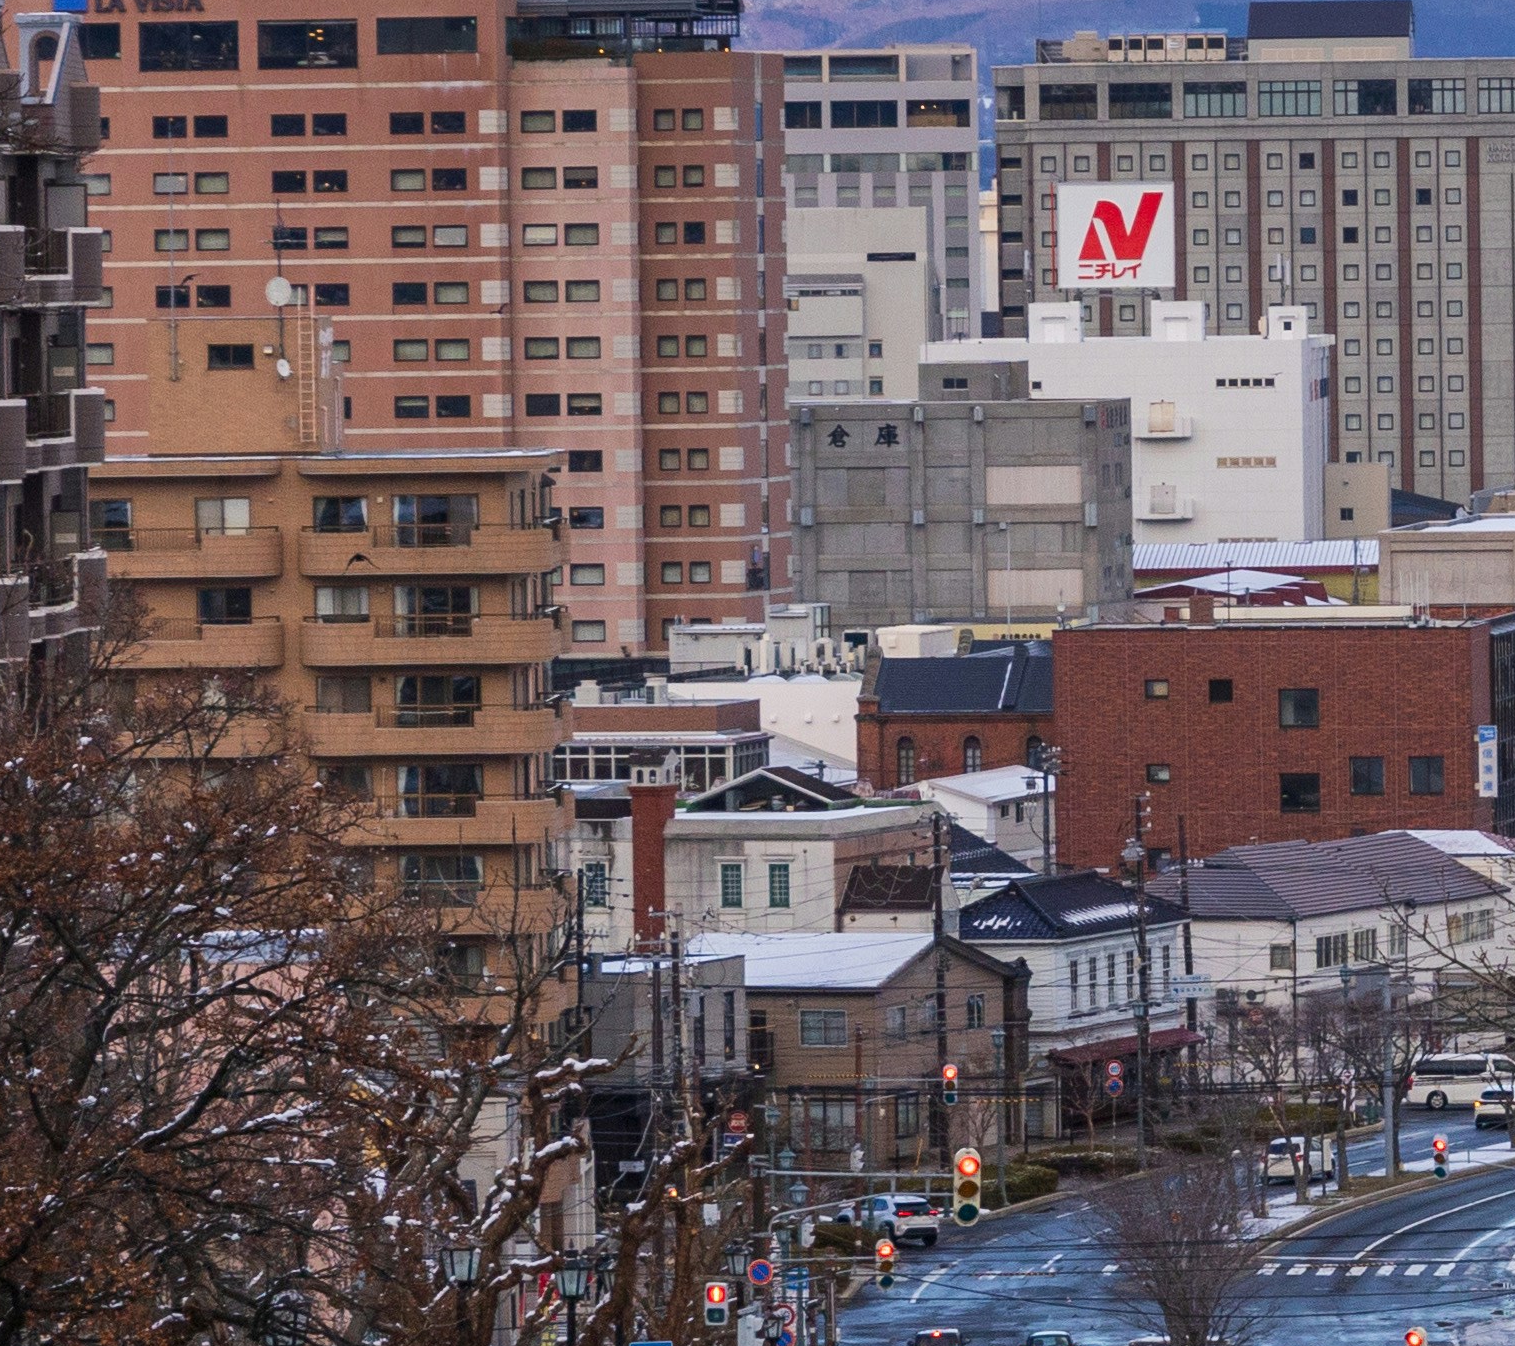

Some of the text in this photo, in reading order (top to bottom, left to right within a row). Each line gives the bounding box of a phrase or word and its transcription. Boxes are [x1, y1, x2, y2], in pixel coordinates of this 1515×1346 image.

[1078, 262, 1142, 280] ニチレイ
[828, 424, 899, 447] 倉庫
